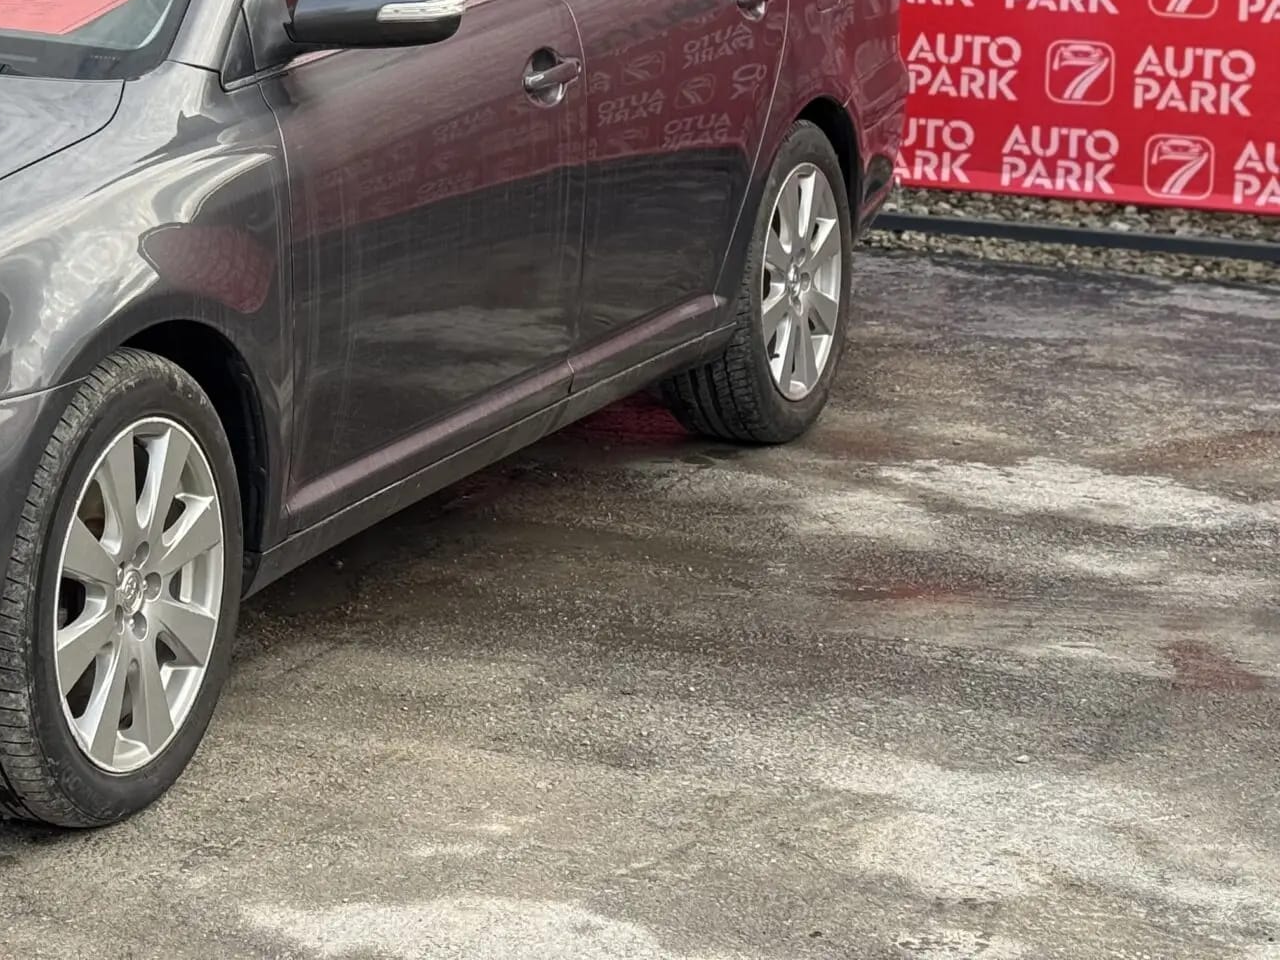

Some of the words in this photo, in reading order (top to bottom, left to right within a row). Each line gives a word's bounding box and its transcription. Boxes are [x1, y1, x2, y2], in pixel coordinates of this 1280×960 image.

[908, 33, 1021, 67] AUTO
[1134, 46, 1255, 82] AUTO
[908, 64, 1017, 100] PARK
[1134, 77, 1251, 116] PARK
[1002, 125, 1119, 161] AUTO
[1000, 156, 1115, 195] PARK
